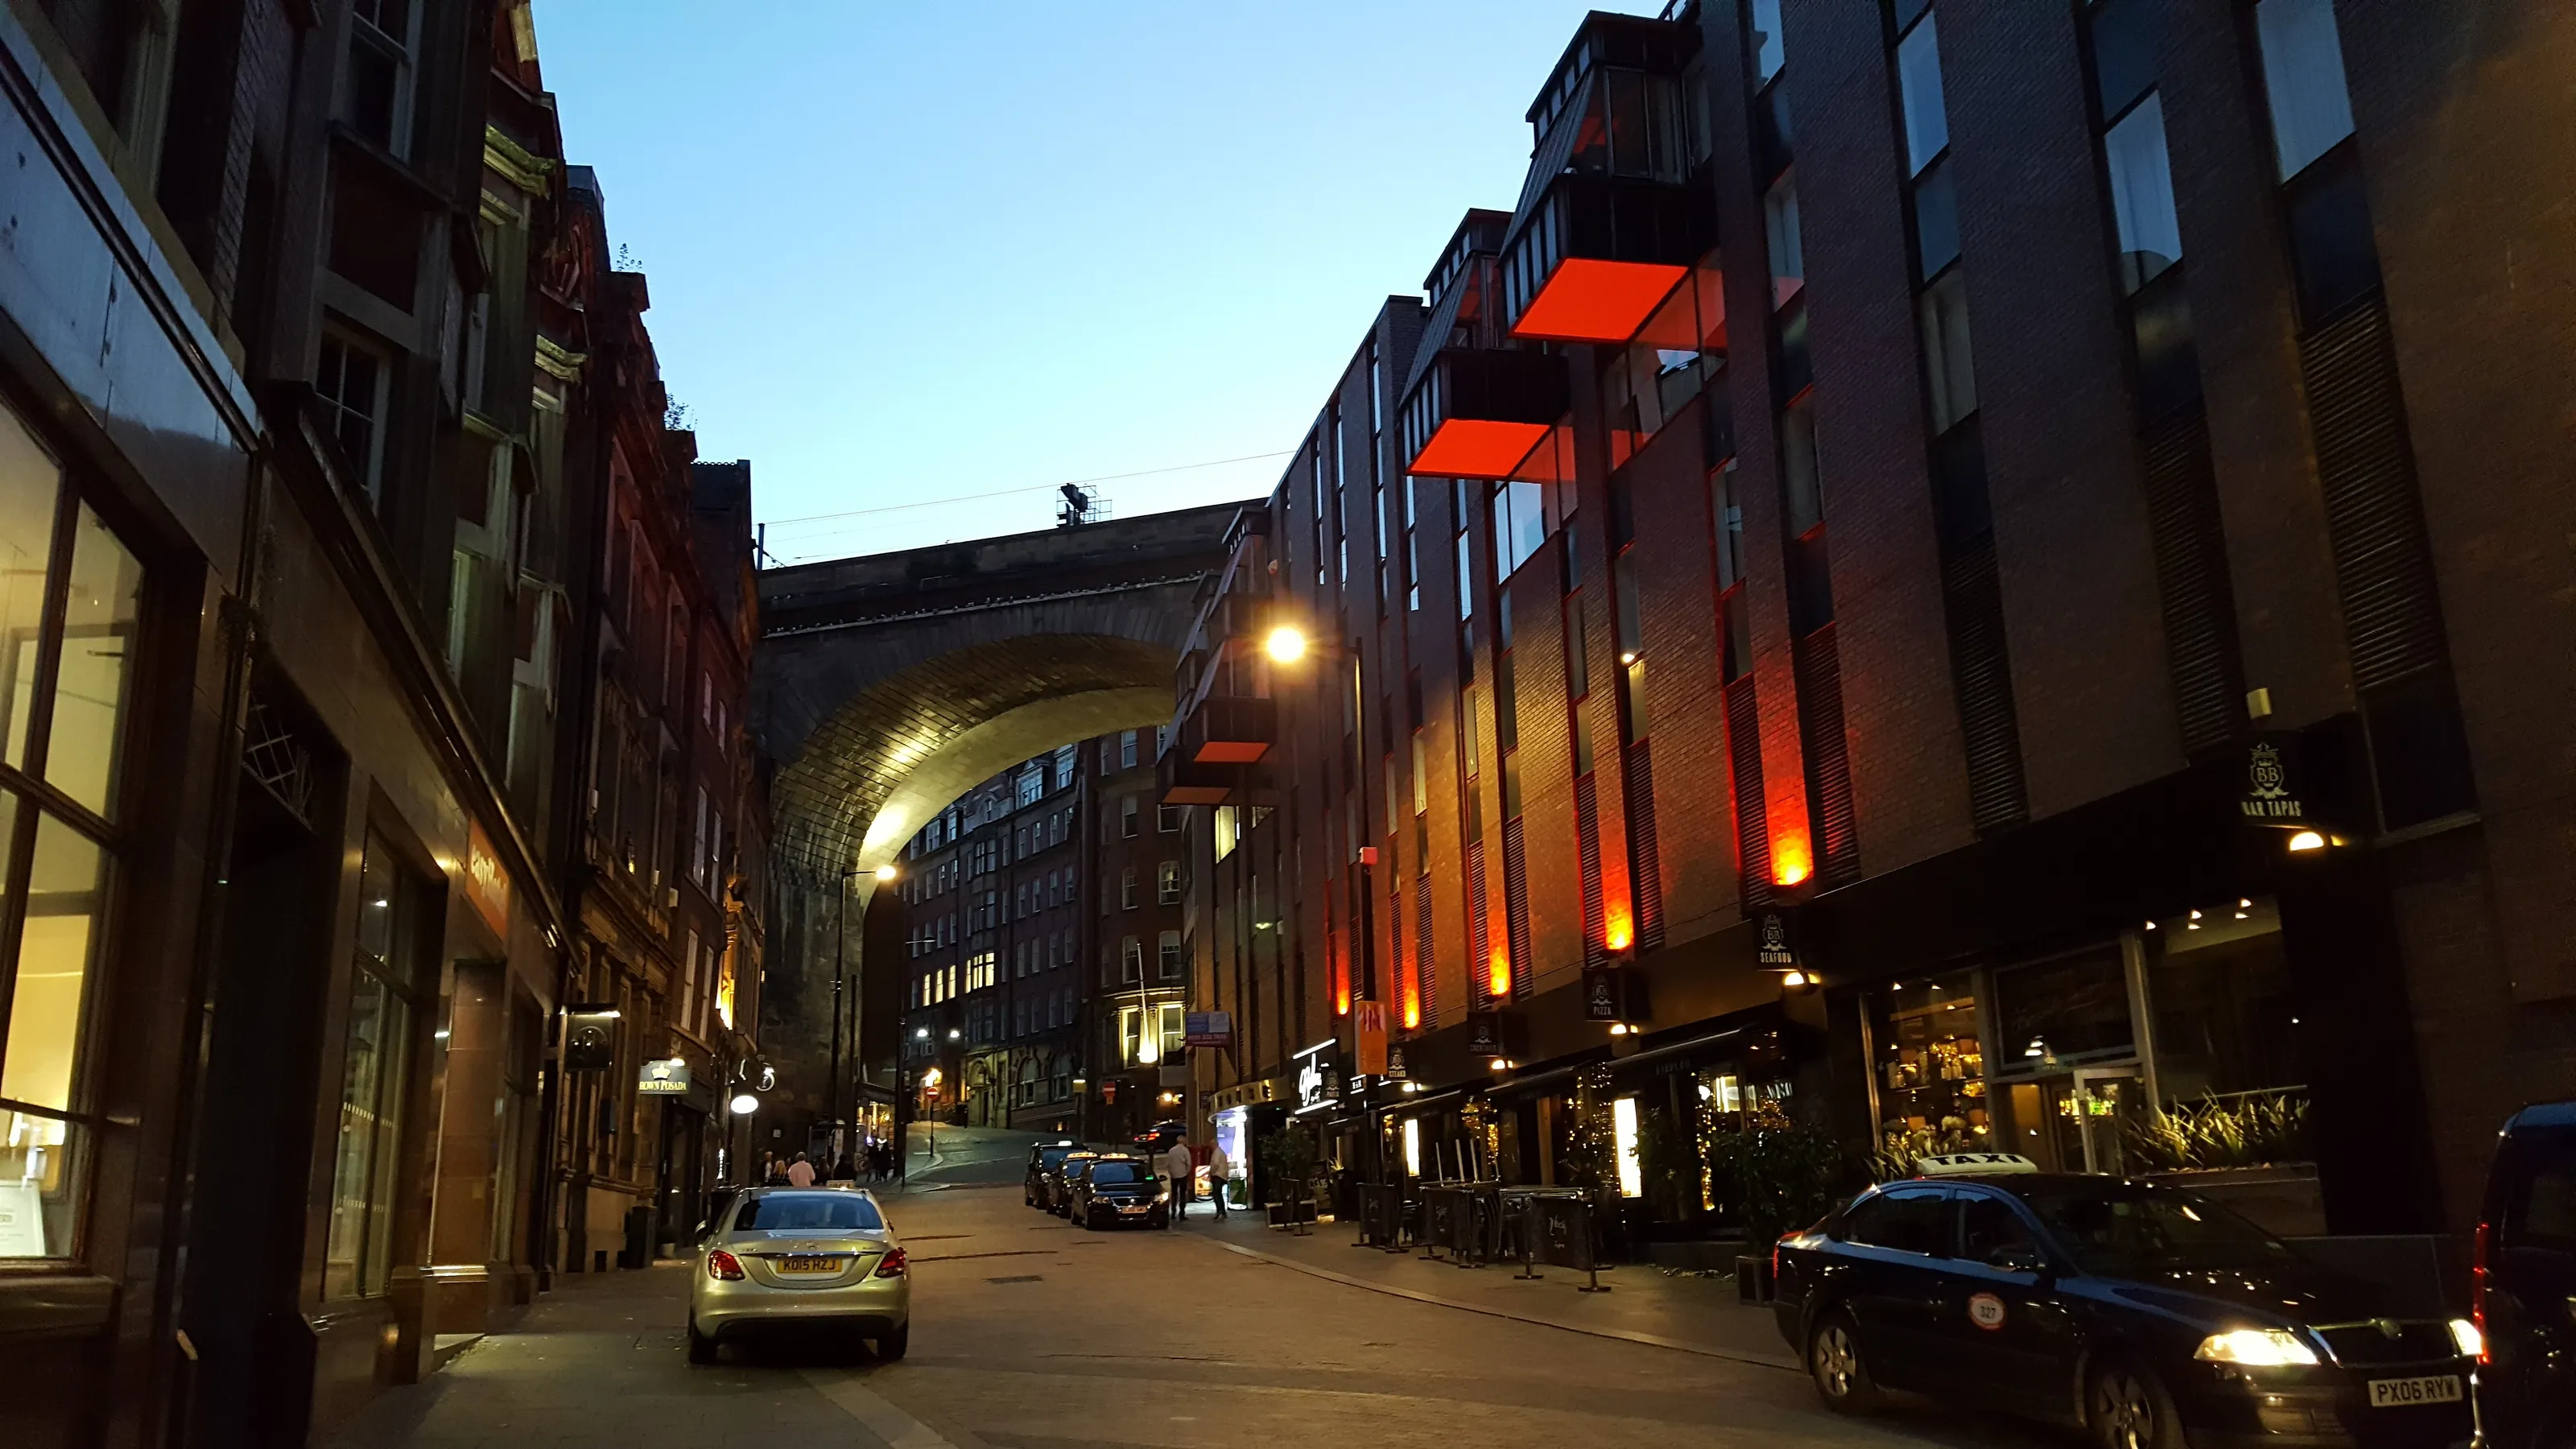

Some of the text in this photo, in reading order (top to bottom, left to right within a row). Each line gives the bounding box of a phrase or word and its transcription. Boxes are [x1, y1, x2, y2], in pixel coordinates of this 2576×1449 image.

[2256, 767, 2280, 782] BB
[2267, 800, 2302, 817] TAPAS
[1760, 952, 1793, 964] SEAFOOD
[1593, 1005, 1612, 1016] PIZZA
[639, 1080, 687, 1091] ROWN POSADA
[1929, 1154, 2023, 1166] TAXI
[812, 1259, 836, 1271] HZJ
[2376, 1381, 2421, 1403] PX06
